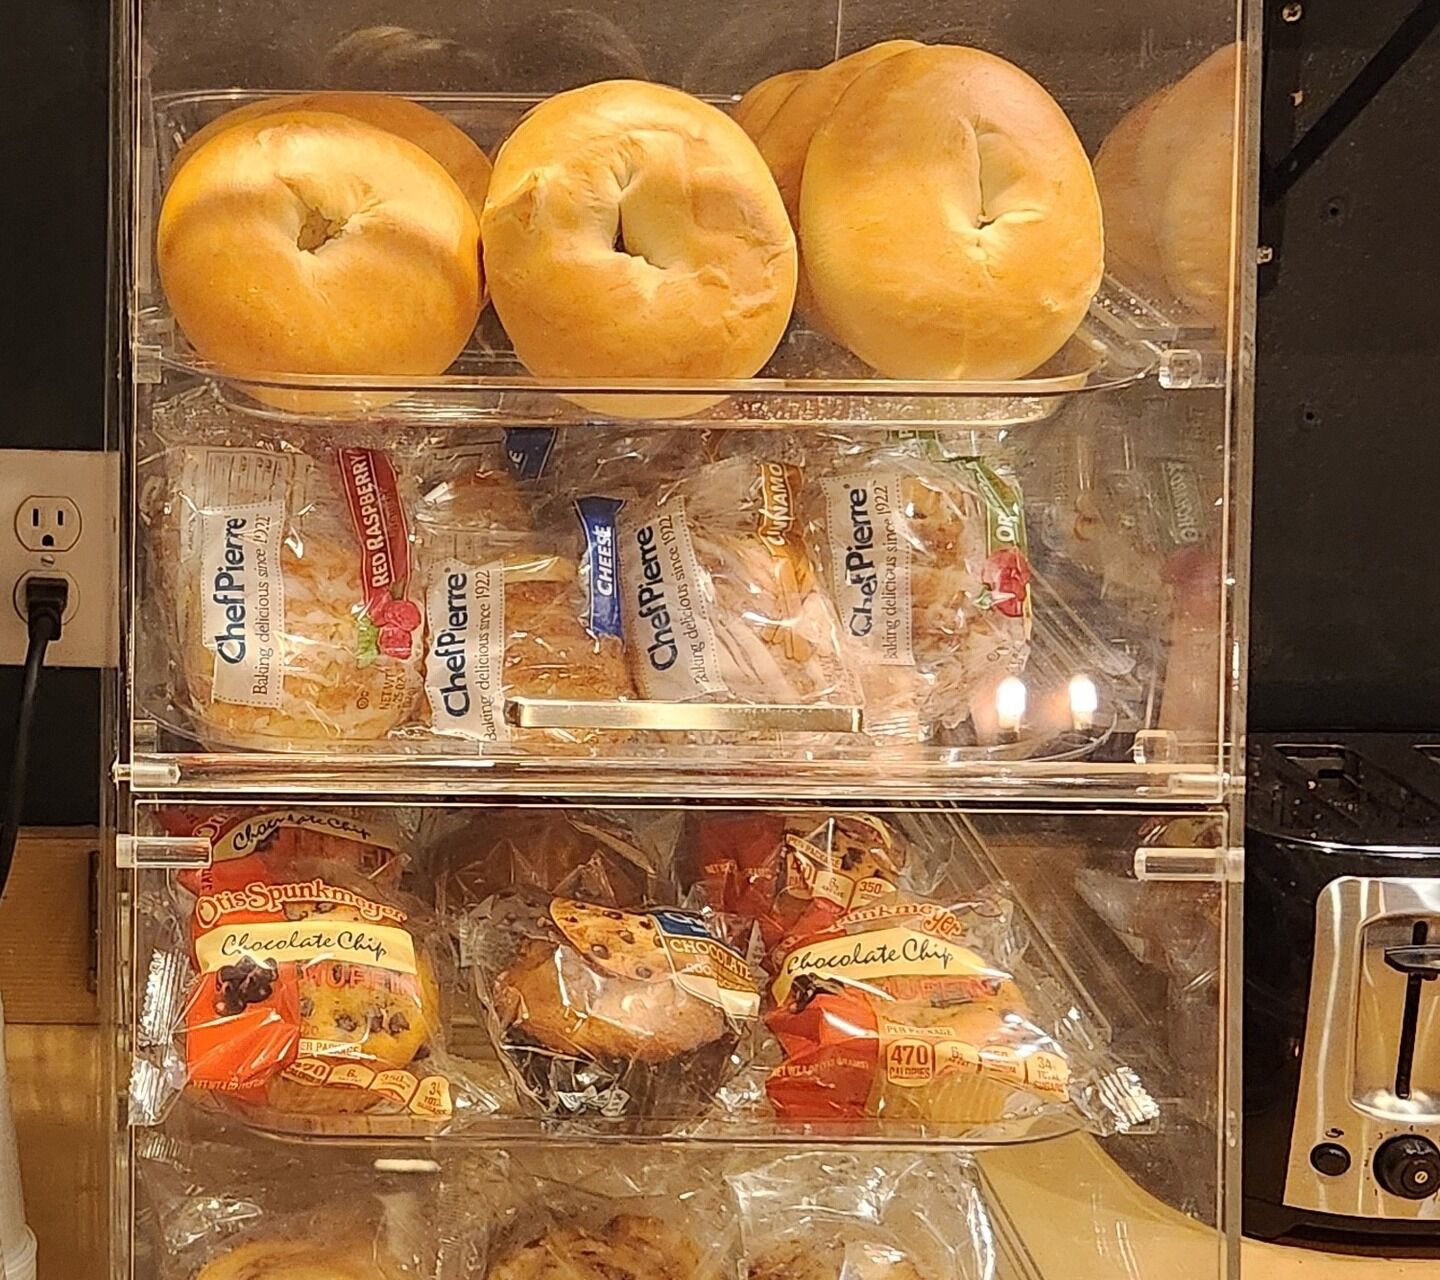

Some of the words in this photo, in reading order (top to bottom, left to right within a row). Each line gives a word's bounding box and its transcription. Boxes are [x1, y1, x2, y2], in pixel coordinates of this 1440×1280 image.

[345, 452, 386, 550] RASPBERRY
[873, 486, 892, 516] 1922
[658, 515, 676, 546] 1922
[254, 549, 269, 578] since
[371, 552, 391, 588] RED
[591, 525, 613, 596] CHEESE
[669, 546, 686, 581] since
[475, 570, 491, 600] 1922
[881, 556, 898, 616] delicious
[254, 582, 271, 642] delicious
[677, 583, 699, 639] delicious
[253, 648, 273, 696] Baking
[474, 633, 491, 690] delicious
[221, 931, 336, 956] Chocolate
[337, 931, 388, 961] Chip
[669, 939, 754, 981] CHOCOLATE
[786, 942, 901, 975] Chocolate
[902, 938, 954, 970] Chip
[890, 1044, 928, 1066] 470
